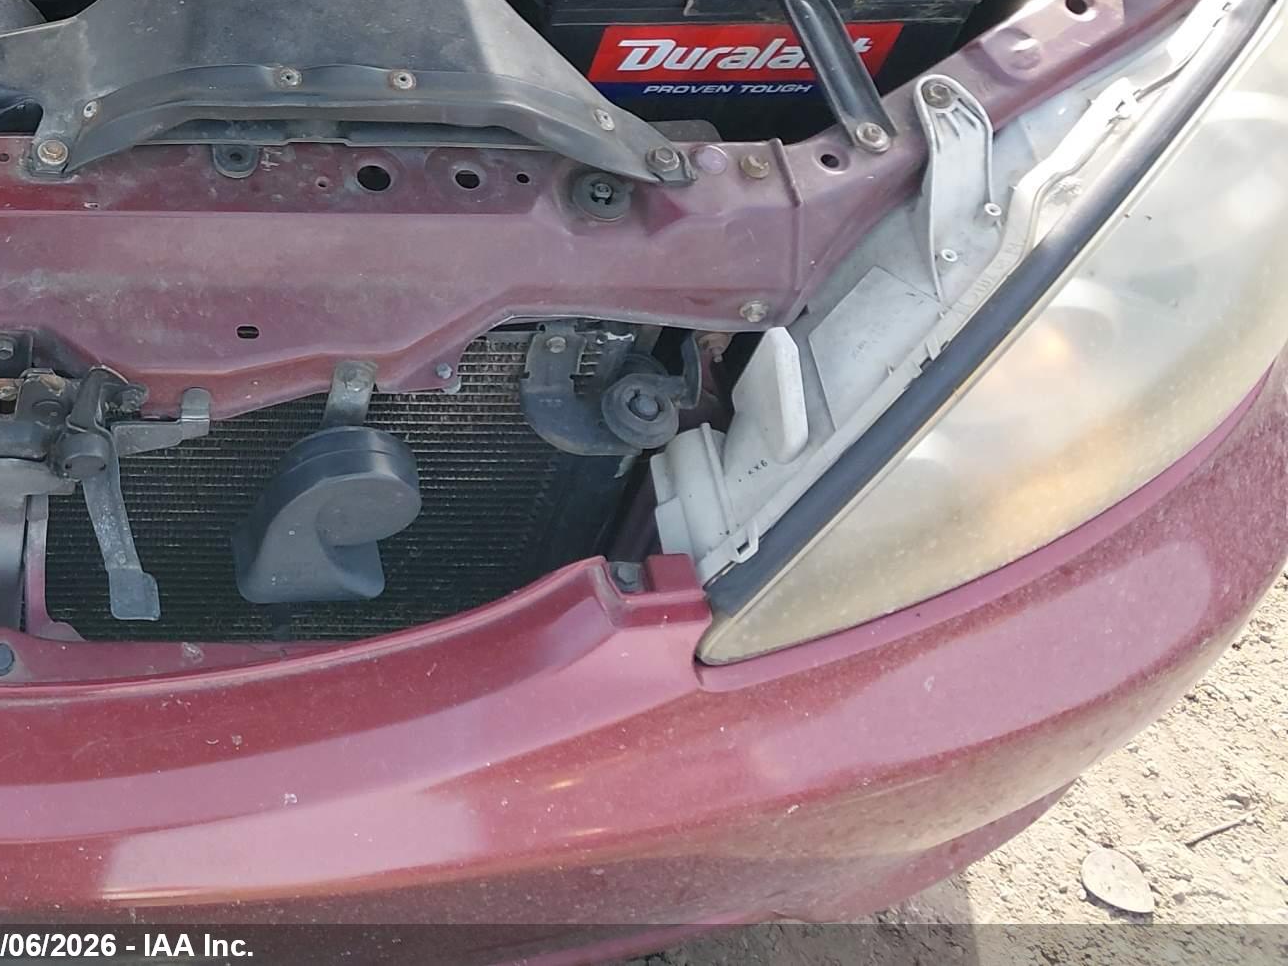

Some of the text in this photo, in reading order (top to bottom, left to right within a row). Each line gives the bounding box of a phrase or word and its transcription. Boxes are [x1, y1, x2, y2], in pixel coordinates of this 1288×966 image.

[617, 38, 873, 71] Durala
[643, 84, 813, 95] PROVEN TOUGH
